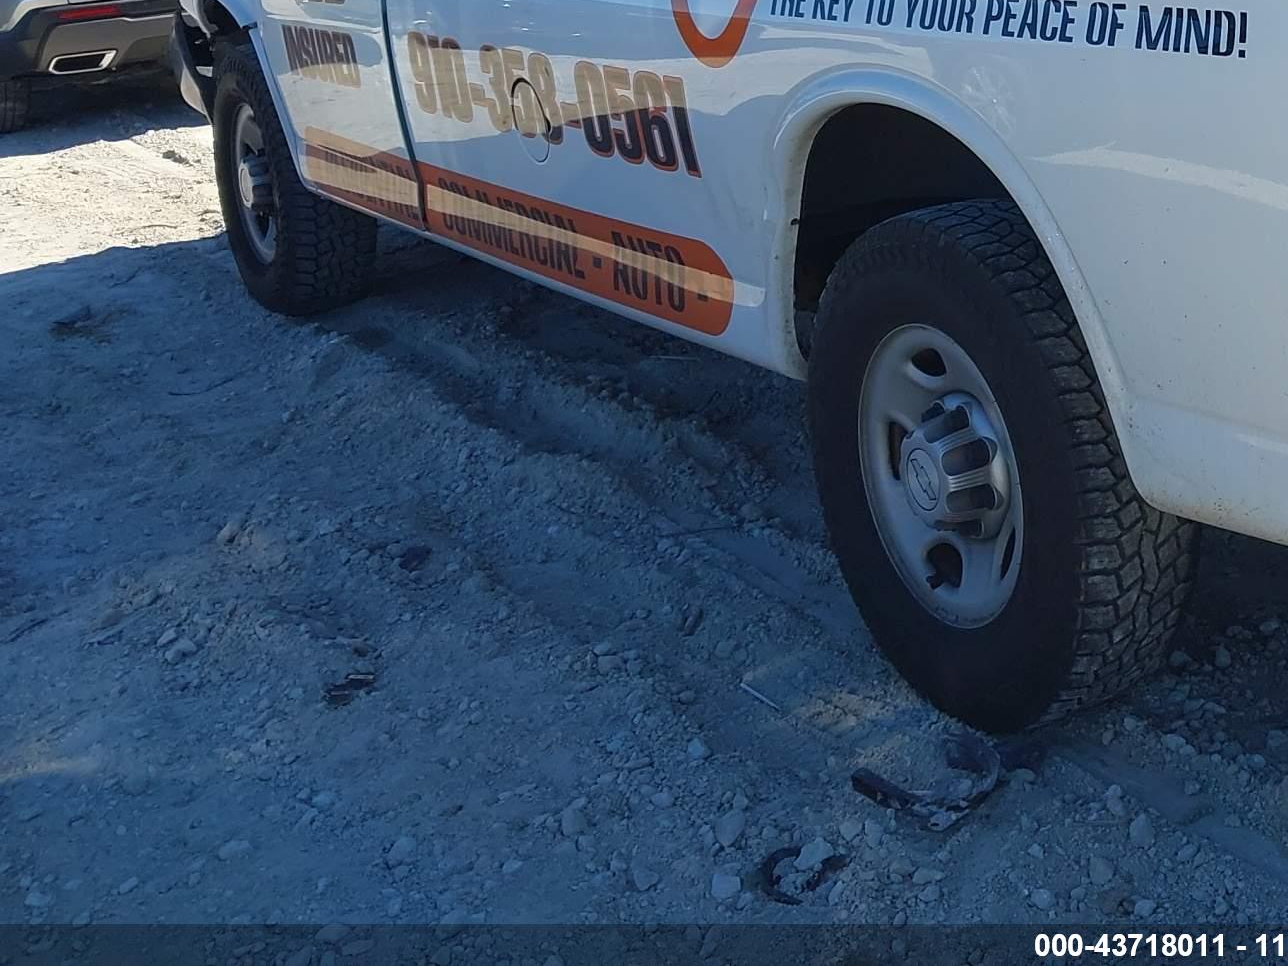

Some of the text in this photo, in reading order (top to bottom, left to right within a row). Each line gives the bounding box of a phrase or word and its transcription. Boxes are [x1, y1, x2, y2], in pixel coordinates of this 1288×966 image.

[281, 23, 361, 89] INSURED
[1085, 0, 1127, 47] OF
[1134, 4, 1249, 59] MIND!
[406, 30, 703, 179] 910-358-0561
[438, 177, 586, 280] COMMERCIAL
[610, 230, 687, 313] AUTO
